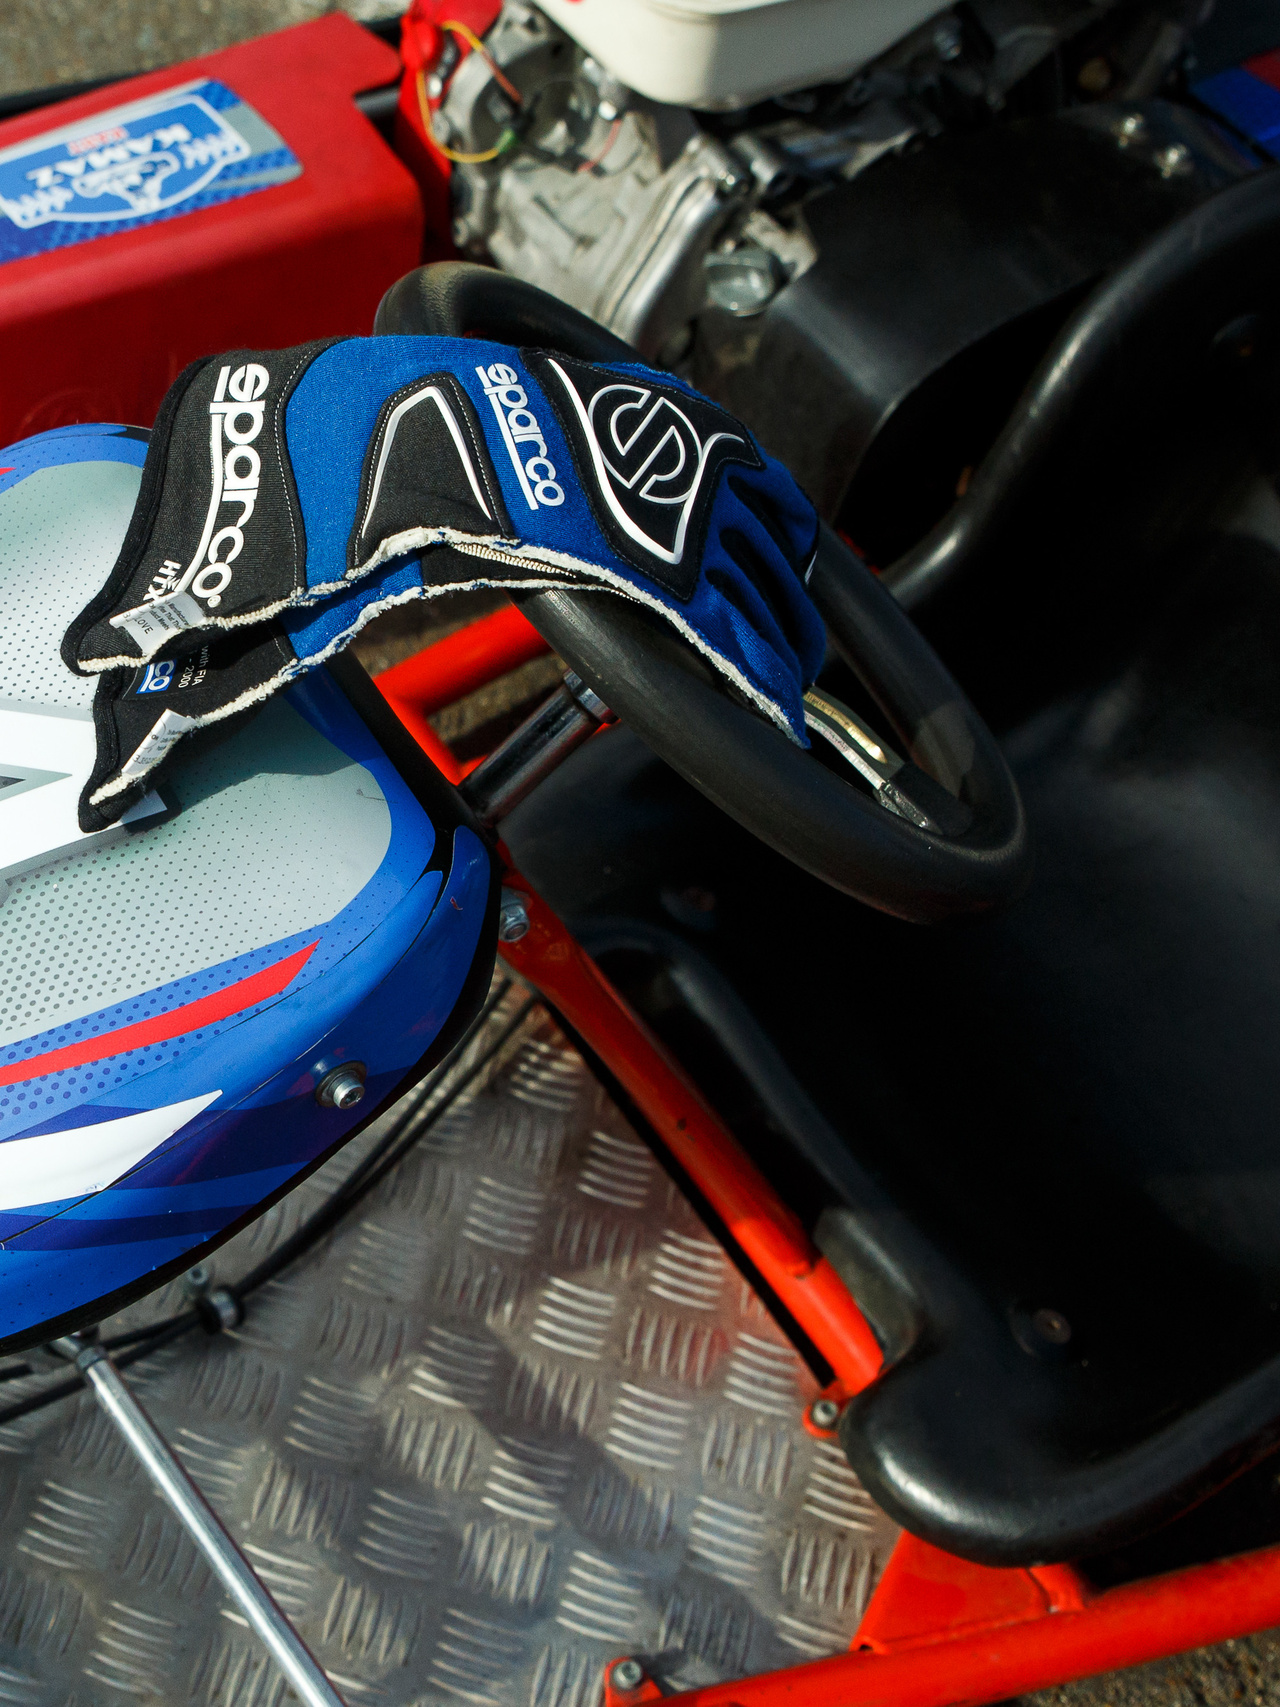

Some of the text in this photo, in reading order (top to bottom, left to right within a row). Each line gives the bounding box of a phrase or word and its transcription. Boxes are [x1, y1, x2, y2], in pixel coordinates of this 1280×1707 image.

[26, 122, 191, 189] KAMAZ
[475, 363, 566, 512] sparco
[191, 362, 271, 604] sparco
[142, 559, 182, 602] HTX
[178, 665, 195, 689] 2000
[191, 669, 207, 687] FIA
